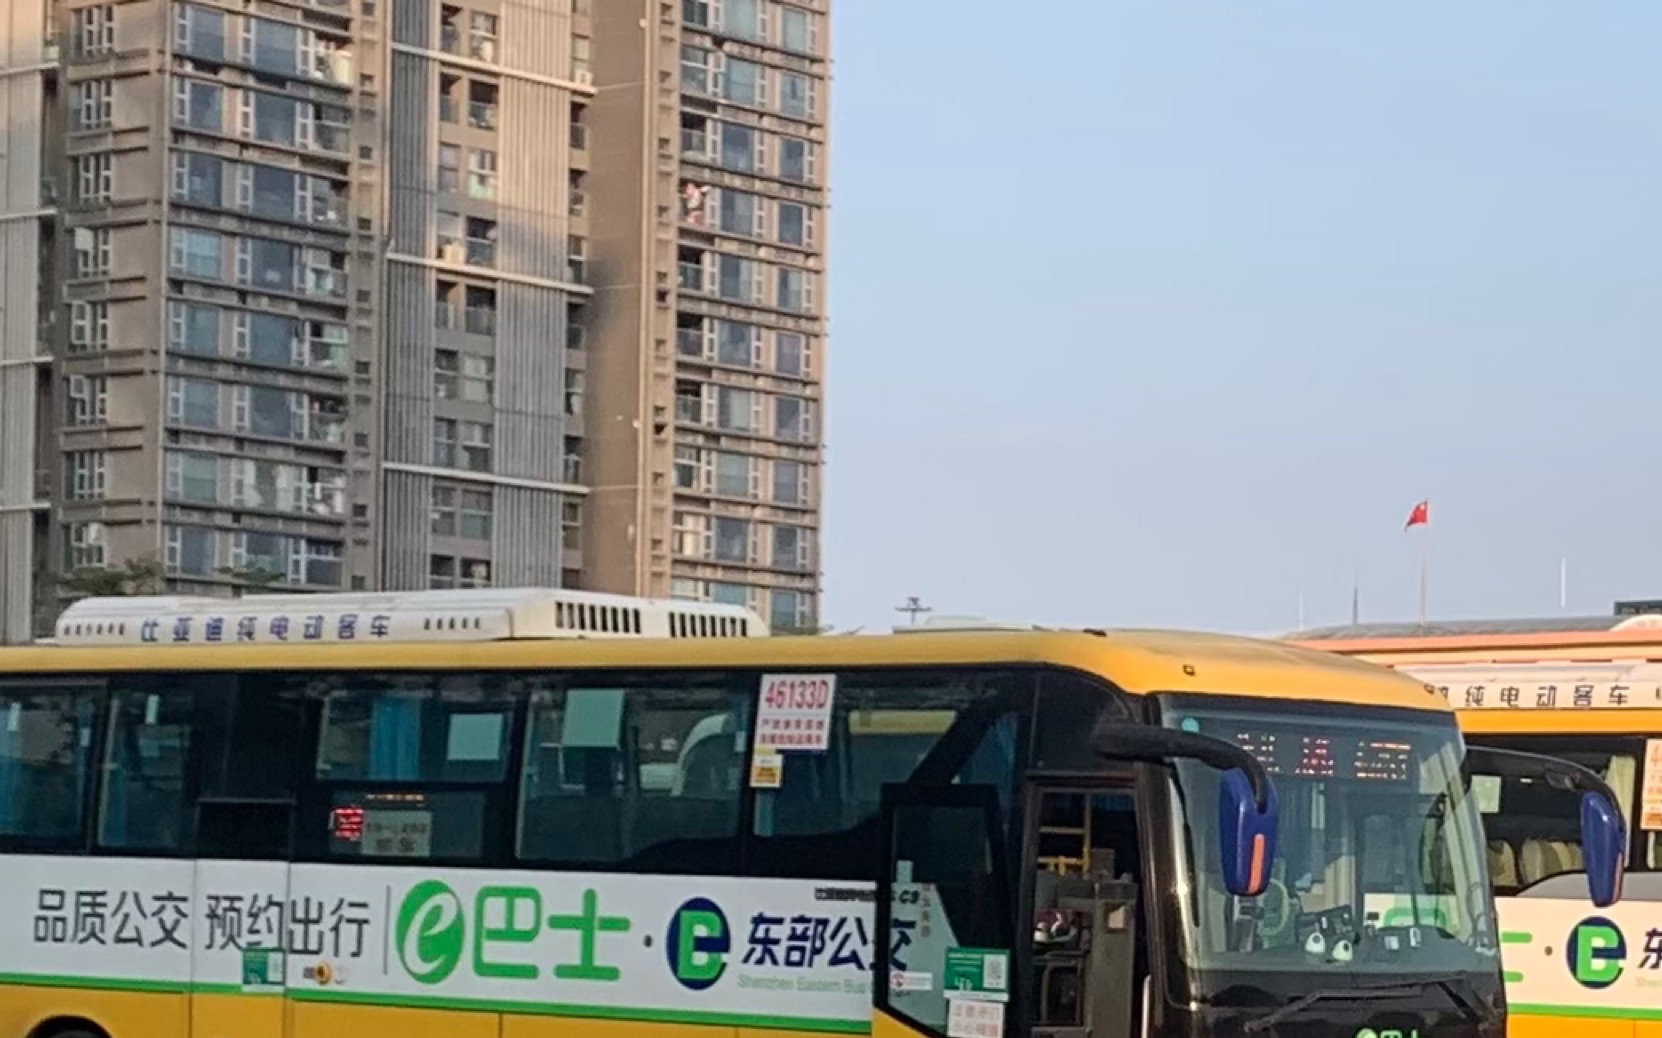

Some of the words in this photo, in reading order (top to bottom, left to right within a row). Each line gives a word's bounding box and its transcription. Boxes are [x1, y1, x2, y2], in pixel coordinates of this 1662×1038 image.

[764, 679, 829, 710] 46133D
[33, 889, 189, 948] 品质公交
[205, 893, 371, 958] 预约出行
[742, 911, 916, 972] 东部公交
